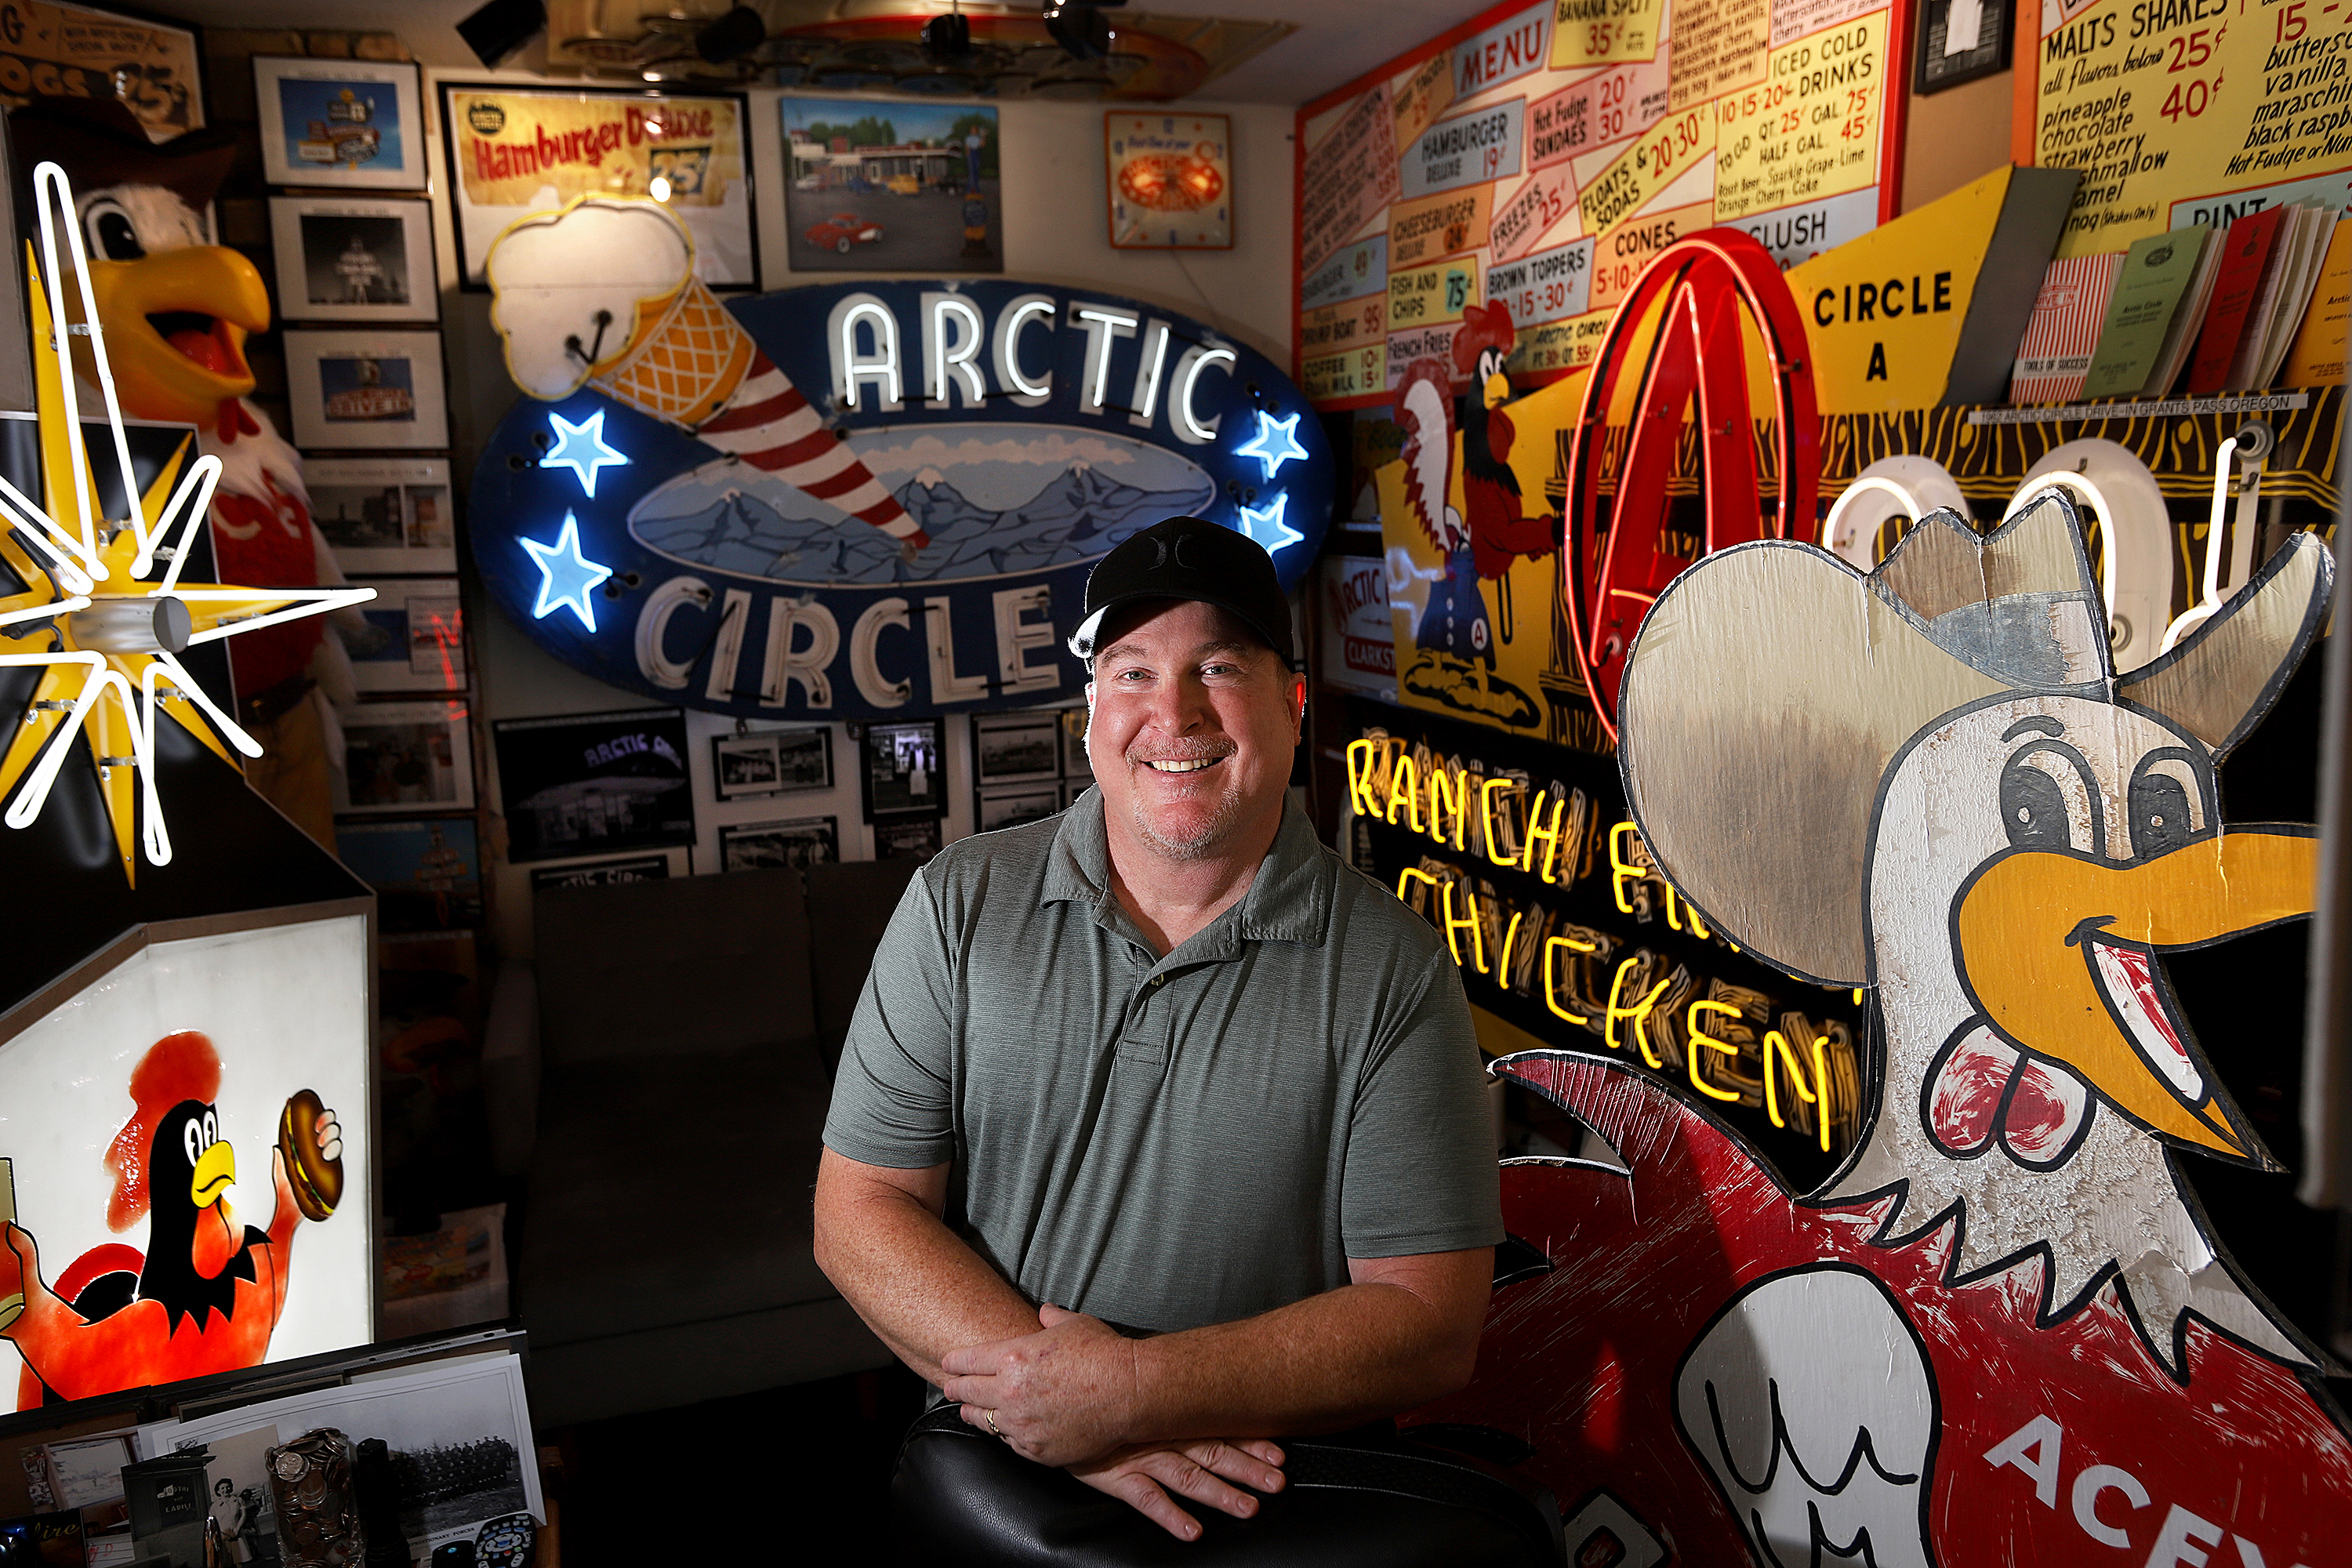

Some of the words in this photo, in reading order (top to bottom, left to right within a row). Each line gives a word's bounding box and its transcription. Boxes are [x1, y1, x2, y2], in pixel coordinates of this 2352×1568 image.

[1774, 23, 1803, 38] cherry
[2045, 13, 2117, 64] MALTS
[2130, 0, 2228, 39] SHAKES
[2167, 19, 2228, 74] 25¢
[1461, 20, 1543, 93] MENU
[1773, 49, 1810, 77] ICED
[1821, 27, 1867, 60] COLD
[2044, 66, 2065, 96] all
[2068, 56, 2119, 94] flavors
[2122, 45, 2164, 74] below
[1800, 53, 1872, 96] DRINKS
[2267, 55, 2347, 97] vanilla
[1534, 102, 1551, 132] Hot
[1555, 95, 1588, 124] Fudge
[2042, 85, 2131, 132] pineapple
[2160, 67, 2224, 124] 40¢
[626, 106, 714, 147] Dluxe
[1421, 112, 1508, 163] HAMBURGER
[1533, 121, 1587, 161] SUNDAES
[2042, 111, 2133, 152] chocolate
[2243, 118, 2295, 151] black
[472, 122, 623, 182] Hamburger
[1719, 153, 1733, 172] TO
[1734, 136, 1750, 158] GO
[1759, 142, 1788, 165] HALF
[2043, 132, 2147, 169] strawberry
[2079, 150, 2169, 187] shmallow
[2223, 153, 2253, 178] Hot
[2252, 144, 2307, 171] Fudge
[2307, 146, 2323, 160] or
[1581, 162, 1630, 218] FLOATS
[1636, 147, 1647, 169] &
[2073, 180, 2125, 209] amel
[1394, 198, 1475, 242] CHEESEBURGER
[1493, 181, 1542, 249] FREEZES
[1595, 180, 1640, 231] SODAS
[1615, 221, 1676, 257] CONES
[1391, 275, 1412, 295] FISH
[1417, 272, 1438, 292] AND
[1489, 267, 1526, 294] BROWN
[1531, 249, 1584, 282] TOPPERS
[1393, 297, 1425, 320] CHIPS
[1814, 271, 1951, 328] CIRCLE
[2122, 303, 2142, 314] Arctic
[2144, 299, 2162, 310] Circle
[1388, 336, 1423, 359] FRENCH
[1424, 330, 1450, 353] FRIES
[1537, 325, 1572, 343] ARCTIC
[1577, 320, 1607, 339] CIRCL
[827, 290, 1239, 445] ARCTIC
[1304, 357, 1345, 378] COFFEE
[1866, 343, 1887, 381] A
[2024, 361, 2043, 372] TOOLS
[2046, 360, 2055, 371] OF
[2058, 358, 2089, 371] SUCCESS
[2004, 408, 2040, 423] ARCTIC
[2043, 407, 2083, 421] CIRCLE
[2085, 405, 2136, 419] DRIVE-IN
[2139, 401, 2189, 416] GRANTS
[2193, 399, 2226, 414] PASS
[2230, 396, 2290, 412] OREGON
[1327, 568, 1380, 637] ARCTIC
[635, 575, 1061, 710] CIRCLE
[1474, 624, 1484, 644] A
[584, 731, 649, 769] ARCTIC
[1346, 738, 1565, 884] RANCH
